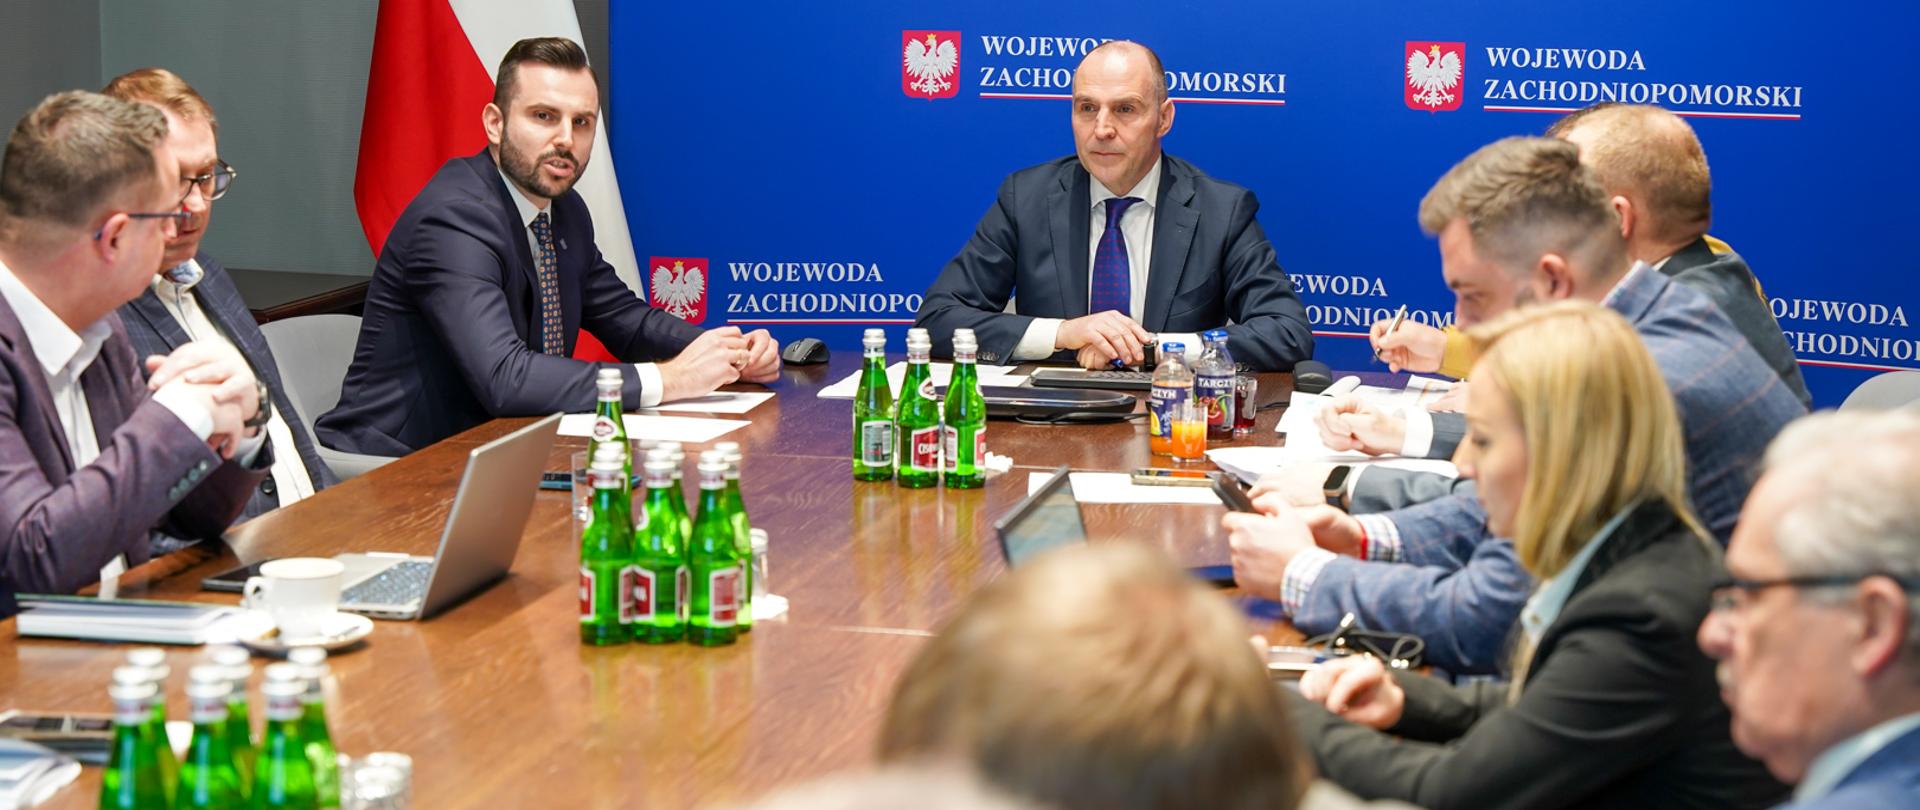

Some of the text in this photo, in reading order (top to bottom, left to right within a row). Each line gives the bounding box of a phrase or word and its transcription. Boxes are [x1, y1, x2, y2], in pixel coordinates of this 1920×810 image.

[981, 35, 1131, 57] WOJEWO
[1486, 47, 1646, 71] WOJEWODA
[979, 67, 1287, 94] ZACHOOMORSKI
[1484, 79, 1802, 107] ZACHODNIOPOMORSKI
[728, 262, 884, 282] WOJEWODA
[1288, 273, 1388, 297] EWODA
[727, 293, 924, 313] ZACHODNIOPO
[1769, 297, 1908, 327] OJEWODA
